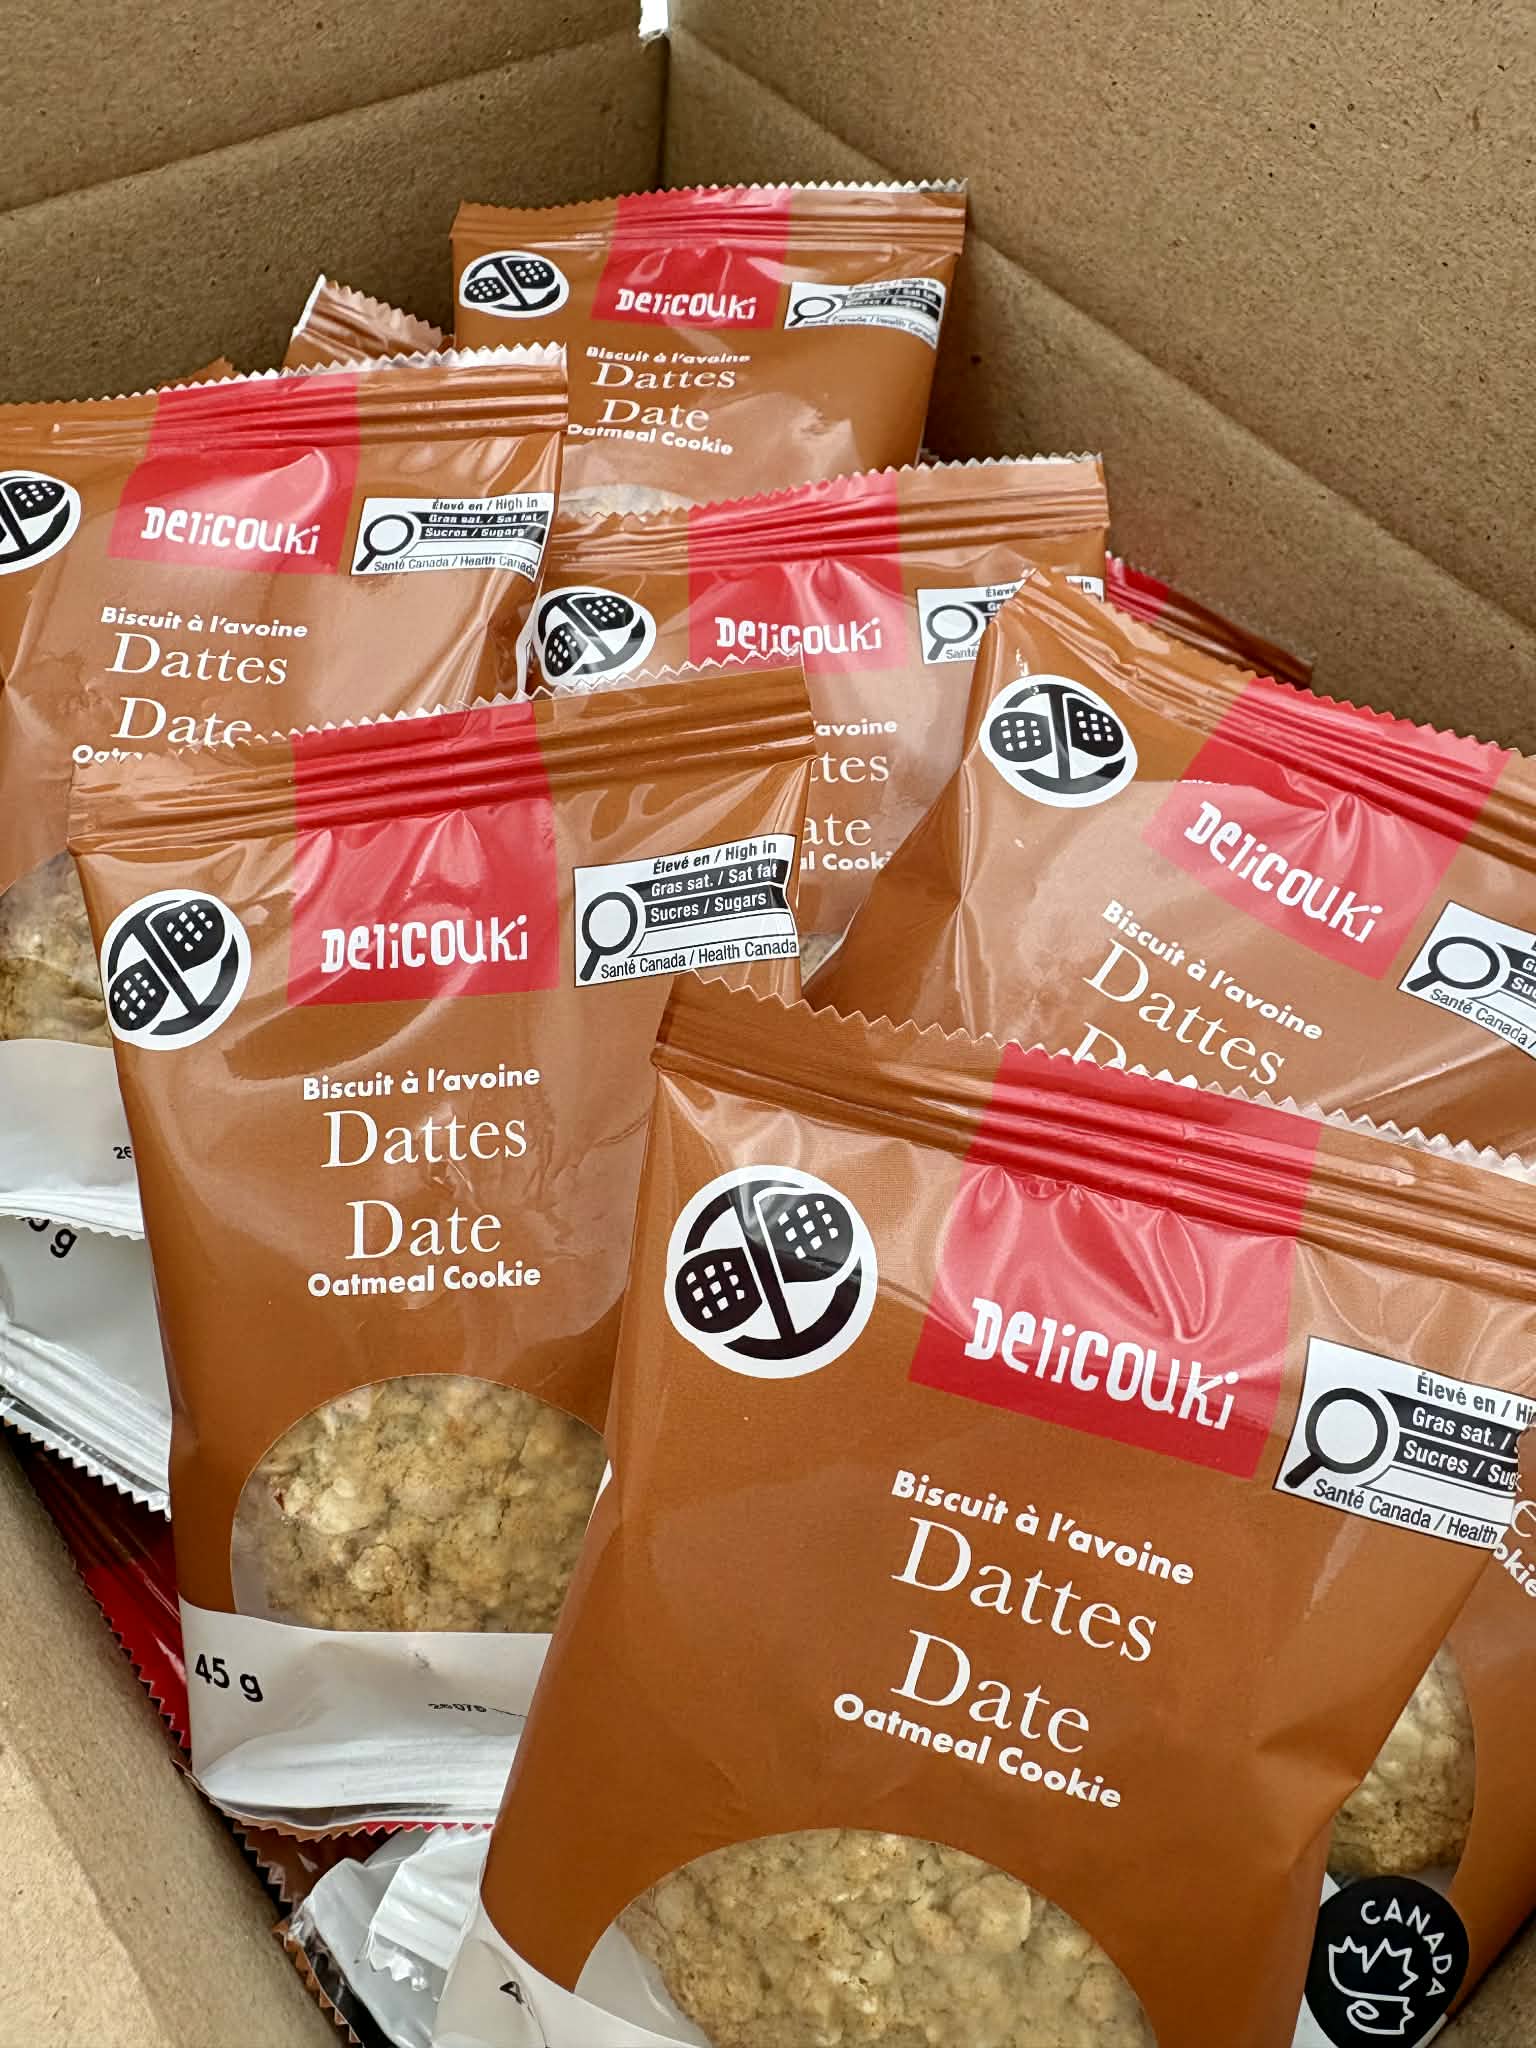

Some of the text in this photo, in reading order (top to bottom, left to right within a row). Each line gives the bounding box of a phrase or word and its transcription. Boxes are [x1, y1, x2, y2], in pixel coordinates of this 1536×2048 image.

[586, 346, 650, 363] Biscuit
[590, 361, 737, 389] Dattes
[597, 398, 710, 432] Date
[568, 423, 734, 456] Oatmeal Cookie
[495, 497, 523, 512] High
[526, 496, 539, 509] in
[374, 558, 405, 572] Santé
[408, 558, 449, 571] Canada
[460, 553, 496, 566] Health
[499, 555, 536, 579] Canada
[100, 606, 308, 637] Biscuit à l'avoine
[104, 632, 289, 685] Dattes
[110, 696, 252, 749] Date
[813, 718, 897, 737] 'avoine
[803, 813, 872, 846] ate
[653, 858, 689, 875] Élevé
[694, 854, 710, 867] en
[725, 843, 758, 862] High
[763, 840, 777, 854] in
[651, 881, 683, 898] Gras
[687, 875, 714, 892] sat.
[728, 867, 753, 884] Sat
[756, 862, 778, 880] fat
[650, 903, 699, 923] Sucres
[714, 892, 767, 913] Sugars
[601, 960, 636, 979] Santé
[640, 951, 687, 974] Canada
[698, 944, 740, 965] Health
[744, 939, 797, 956] Canada
[1101, 899, 1323, 1040] Biscuit à l'avoine
[1082, 938, 1285, 1084] Dattes
[1430, 988, 1473, 1014] Santé
[1475, 1007, 1528, 1046] Canada
[303, 1063, 541, 1100] Biscuit à l'avoine
[320, 1109, 528, 1168] Dattes
[344, 1199, 502, 1261] Date
[307, 1260, 541, 1298] Oatmeal Cookie
[1416, 1372, 1466, 1407] Élevé
[1473, 1393, 1495, 1415] en
[1516, 1402, 1536, 1424] Hi
[1412, 1406, 1456, 1435] Gras
[1460, 1423, 1495, 1448] sat.
[1403, 1440, 1469, 1475] Sucres
[891, 1469, 1194, 1585] Biscuit à l'avoine
[1313, 1478, 1366, 1510] Santé
[1369, 1495, 1431, 1530] Canada
[1446, 1515, 1498, 1545] Health
[890, 1516, 1157, 1663] Dattes
[195, 1653, 264, 1703] 45 g
[889, 1629, 1090, 1753] Date
[833, 1693, 1121, 1809] Oatmeal Cookie
[1360, 1897, 1453, 1997] CANADA
